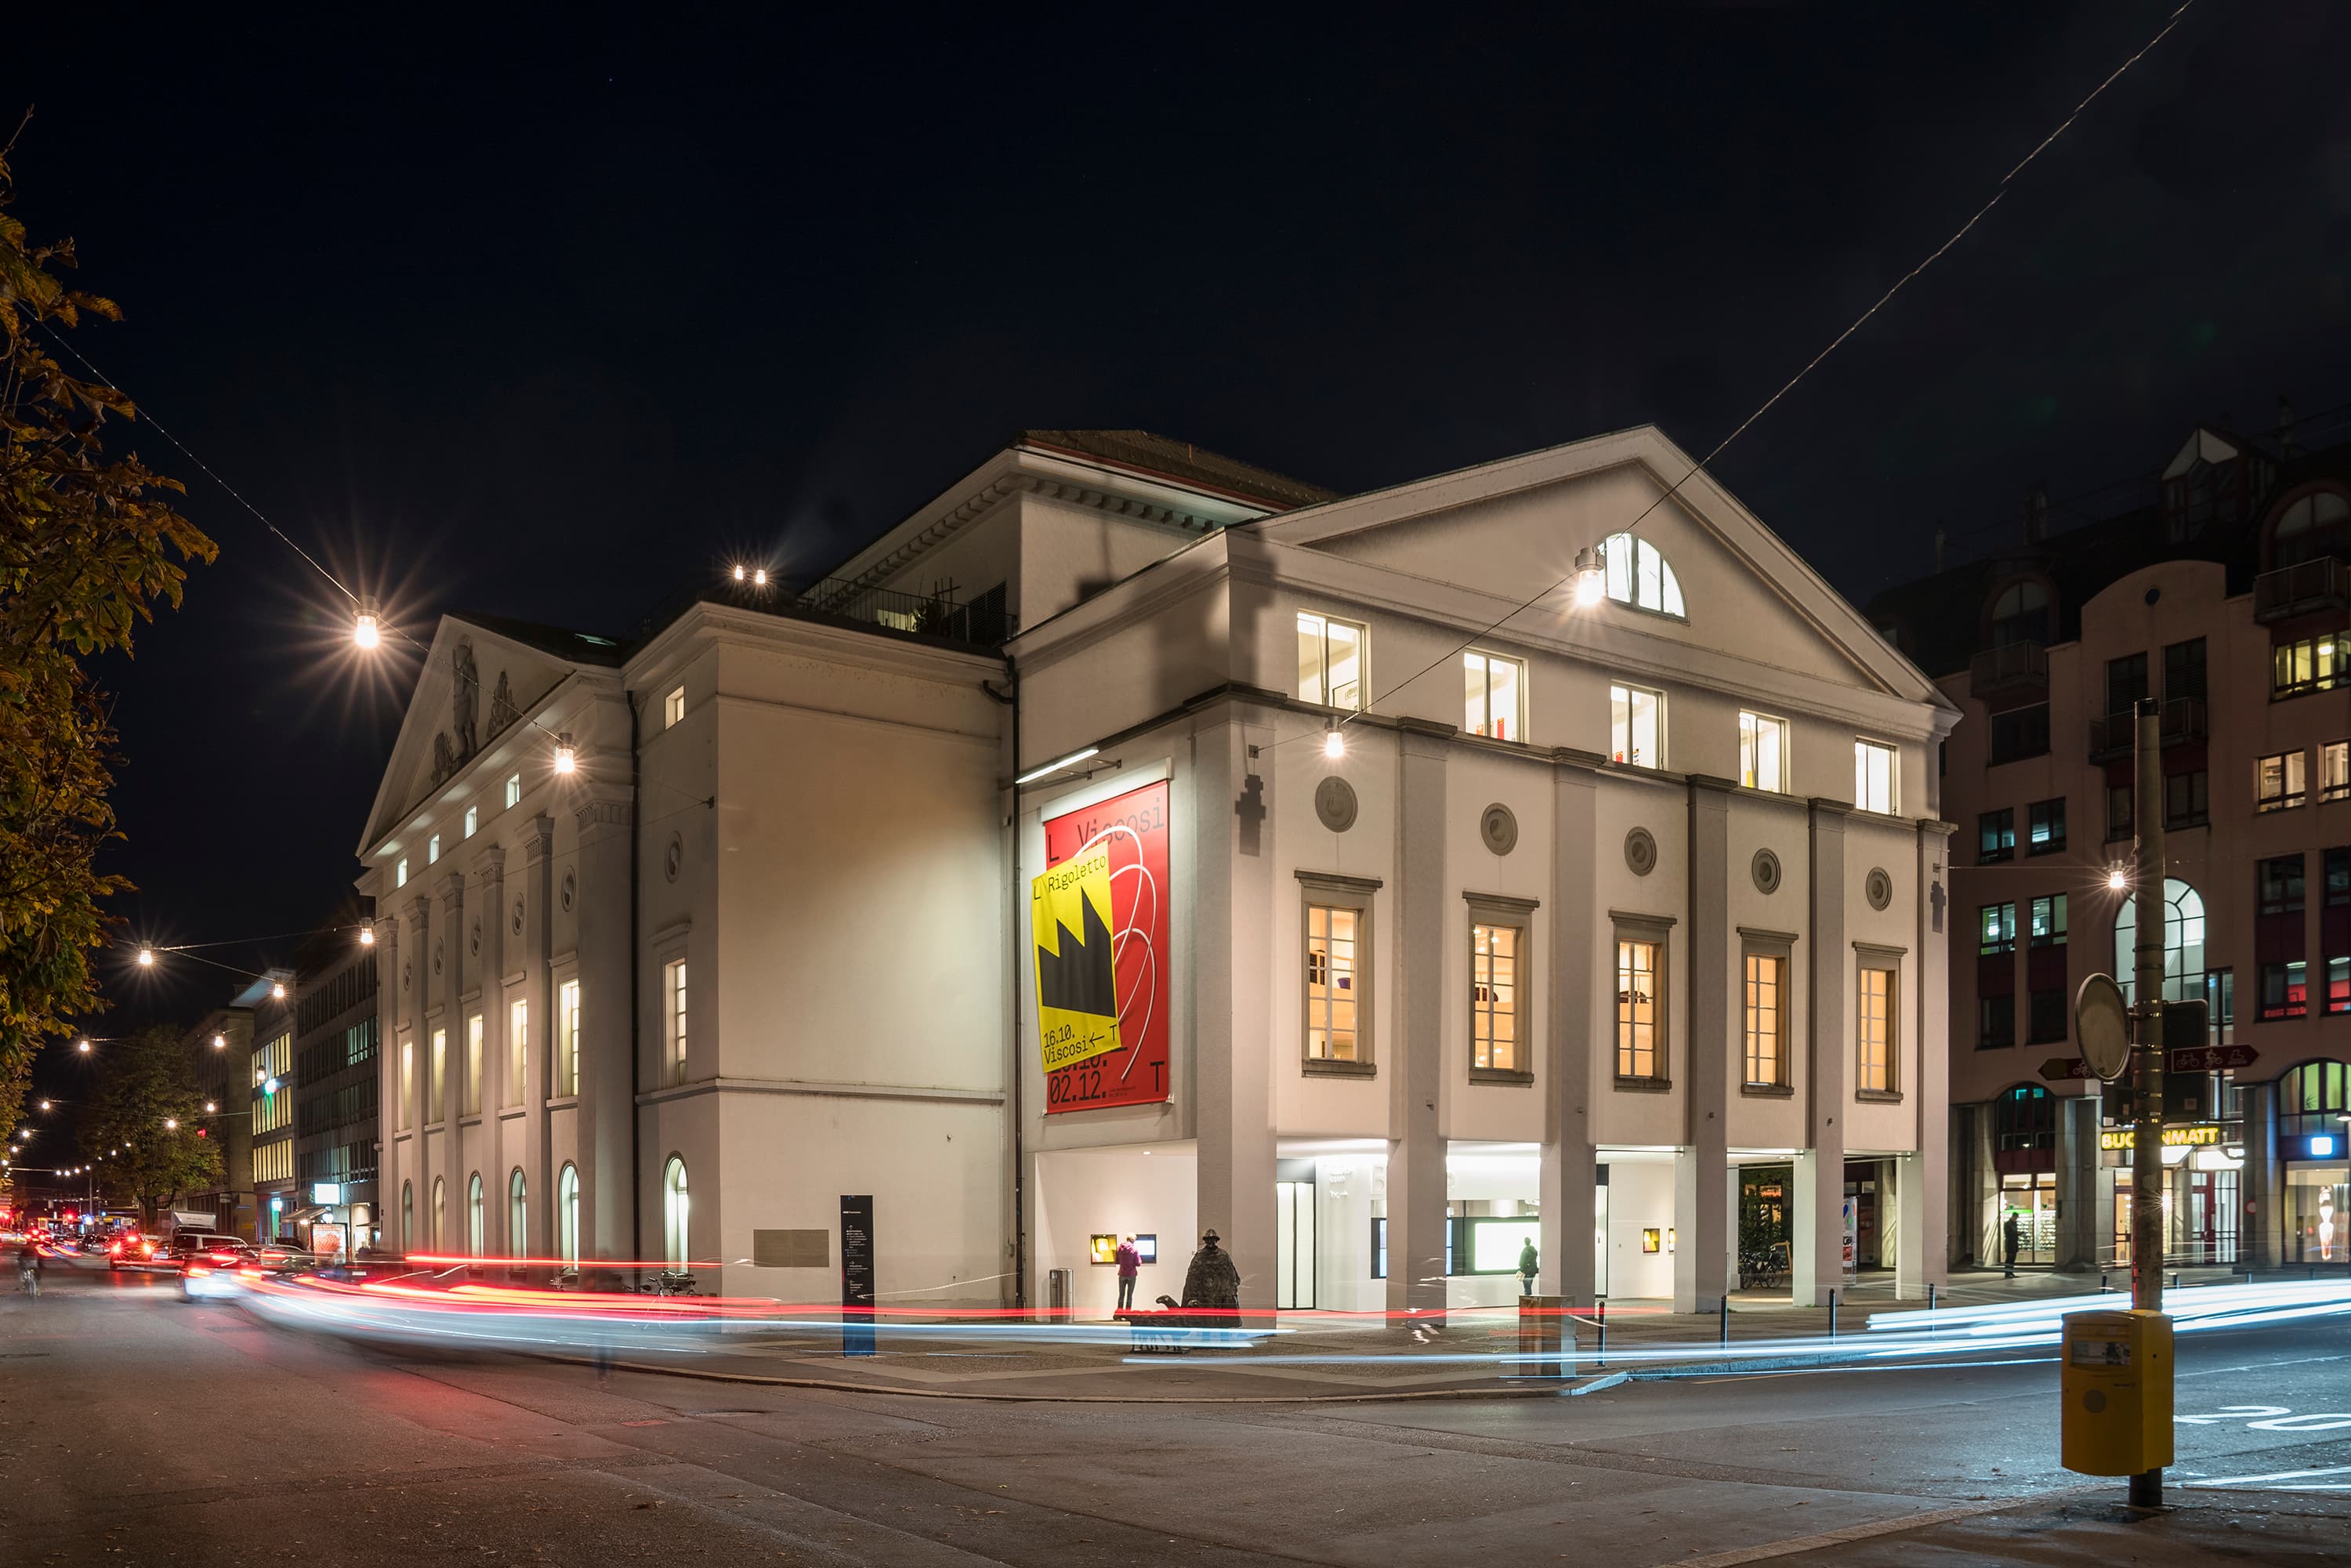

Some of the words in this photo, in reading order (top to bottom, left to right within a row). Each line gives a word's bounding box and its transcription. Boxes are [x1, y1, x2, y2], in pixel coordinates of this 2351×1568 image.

[1048, 834, 1060, 863] L
[1078, 797, 1165, 851] Viscosi
[1034, 884, 1041, 900] L
[1048, 855, 1107, 893] Rigoletto
[1043, 1024, 1075, 1048] 16.10.
[1044, 1035, 1089, 1064] Viscosi
[1110, 1024, 1118, 1041] T
[1050, 1070, 1107, 1104] 02.12.
[1150, 1060, 1165, 1092] T
